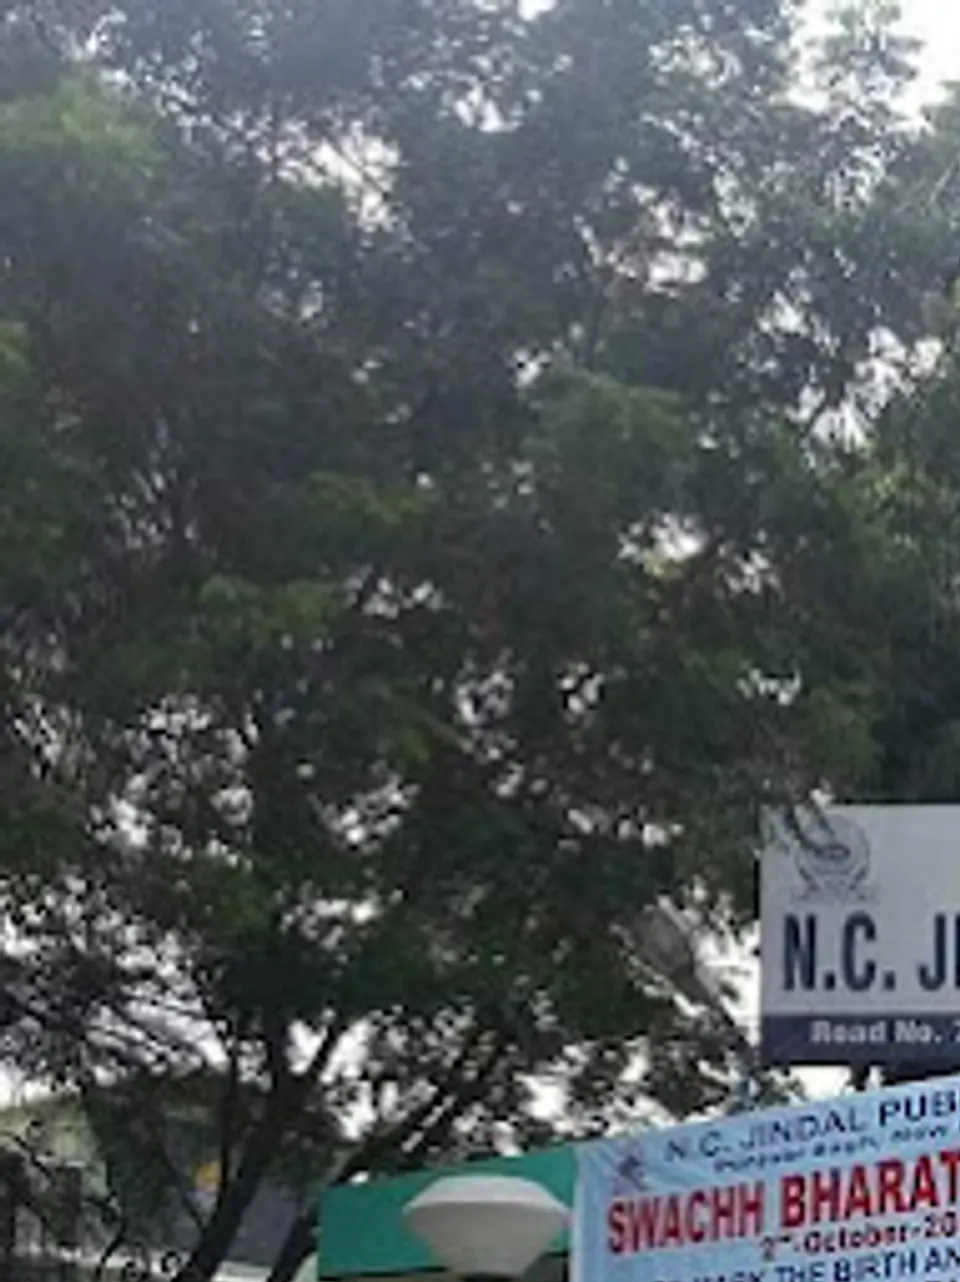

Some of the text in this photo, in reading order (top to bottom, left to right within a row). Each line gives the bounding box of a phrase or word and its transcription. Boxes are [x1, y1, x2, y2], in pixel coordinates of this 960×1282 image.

[783, 910, 896, 993] N.C.
[811, 1019, 886, 1044] Road
[896, 1019, 941, 1043] No.
[606, 1181, 765, 1255] SWACHH
